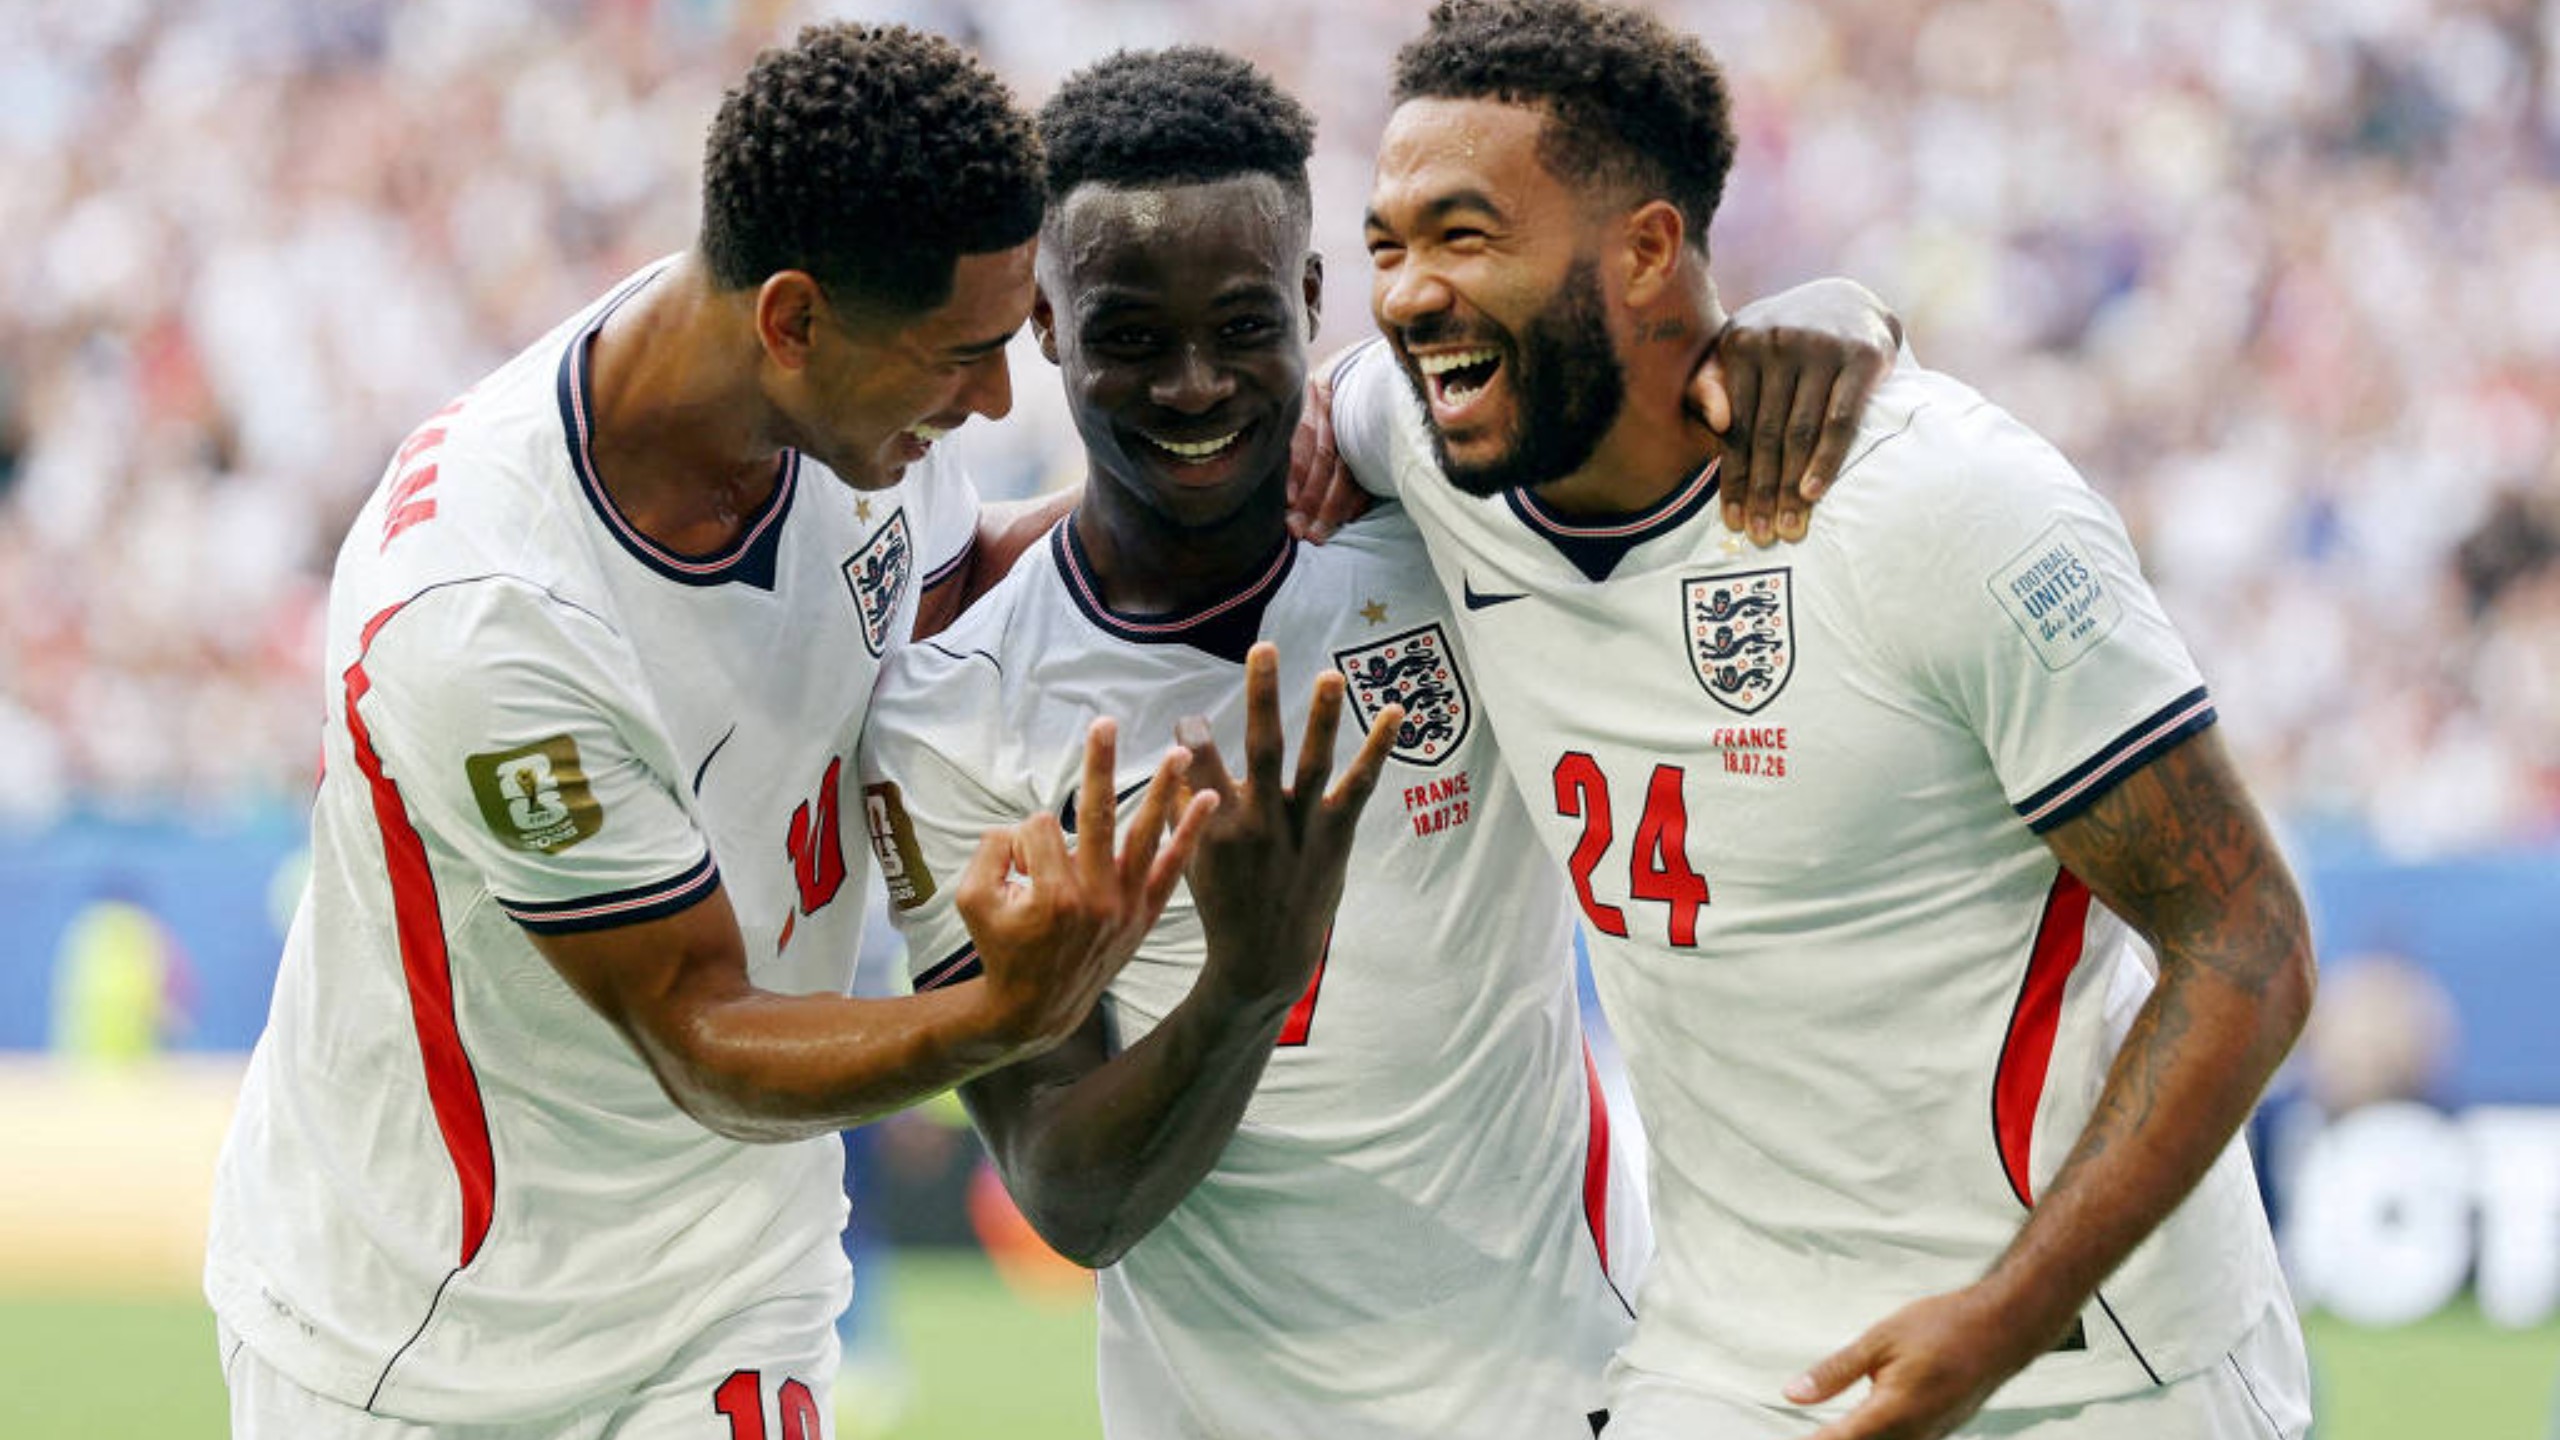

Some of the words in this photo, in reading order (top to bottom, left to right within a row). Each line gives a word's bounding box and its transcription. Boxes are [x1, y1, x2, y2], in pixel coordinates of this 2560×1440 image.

[2010, 542, 2073, 598] FOOTBALL
[2022, 558, 2089, 619] UNITES
[2039, 618, 2065, 642] the
[1712, 728, 1788, 750] FRANCE
[1723, 750, 1786, 777] 18.07.26
[1552, 751, 1711, 948] 24
